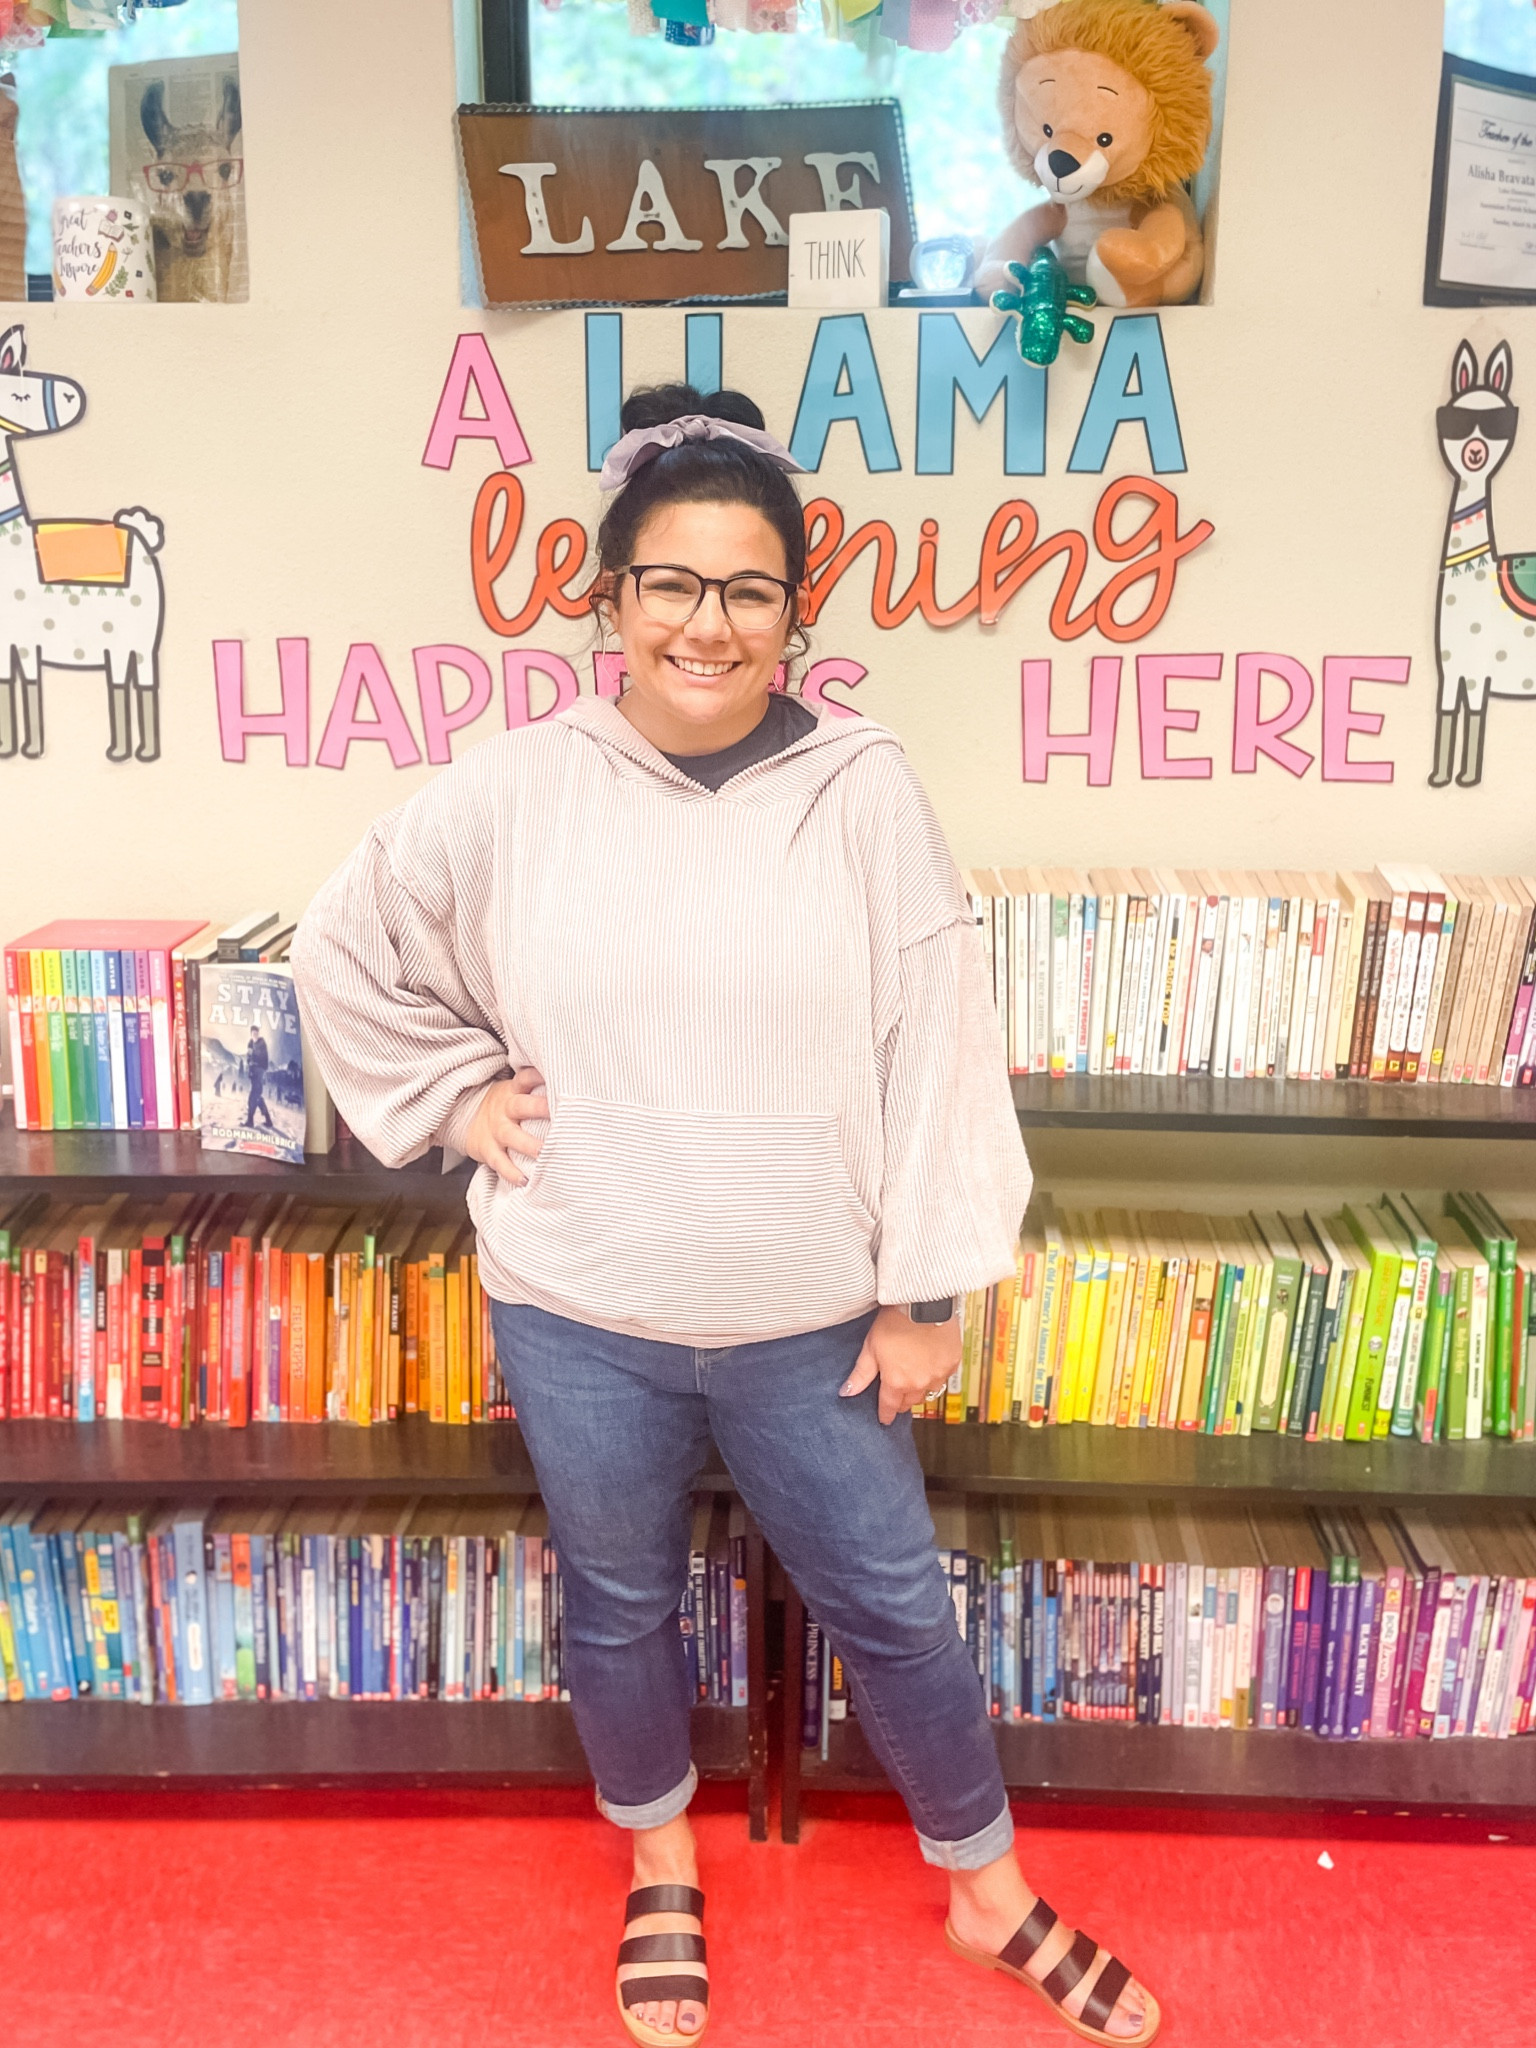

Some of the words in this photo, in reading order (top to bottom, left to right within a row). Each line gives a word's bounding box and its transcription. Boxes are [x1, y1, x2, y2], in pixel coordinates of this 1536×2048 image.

[1467, 163, 1496, 182] Alisha
[1498, 168, 1536, 187] Bravata
[498, 151, 887, 255] LAKE
[804, 238, 867, 281] THINK
[421, 333, 533, 470] A
[469, 471, 1216, 643] lening
[1021, 652, 1412, 787] HERE
[217, 983, 289, 1011] STAY
[209, 1004, 297, 1035] ALIVE
[1046, 1267, 1056, 1283] Old
[1048, 1249, 1058, 1264] The
[80, 1298, 90, 1314] ME
[97, 1291, 105, 1328] TITANIC
[293, 1305, 302, 1332] FIELD
[1042, 1286, 1054, 1324] Farmer's
[149, 1304, 157, 1346] ELEPHANTS
[80, 1318, 91, 1397] EVERYTHING
[294, 1336, 304, 1380] TRIPPED
[1038, 1328, 1049, 1365] Almanac
[1037, 1368, 1046, 1381] for
[1034, 1384, 1044, 1403] Kids
[1141, 1589, 1151, 1612] DAVY
[1153, 1591, 1163, 1633] BUFFALO
[806, 1623, 819, 1680] PRINCESS
[1140, 1614, 1151, 1660] CROCKETT
[1152, 1635, 1163, 1655] BILL
[1358, 1624, 1370, 1655] BLACK
[1354, 1658, 1366, 1697] BEAUTY
[1442, 1658, 1456, 1692] ARF
